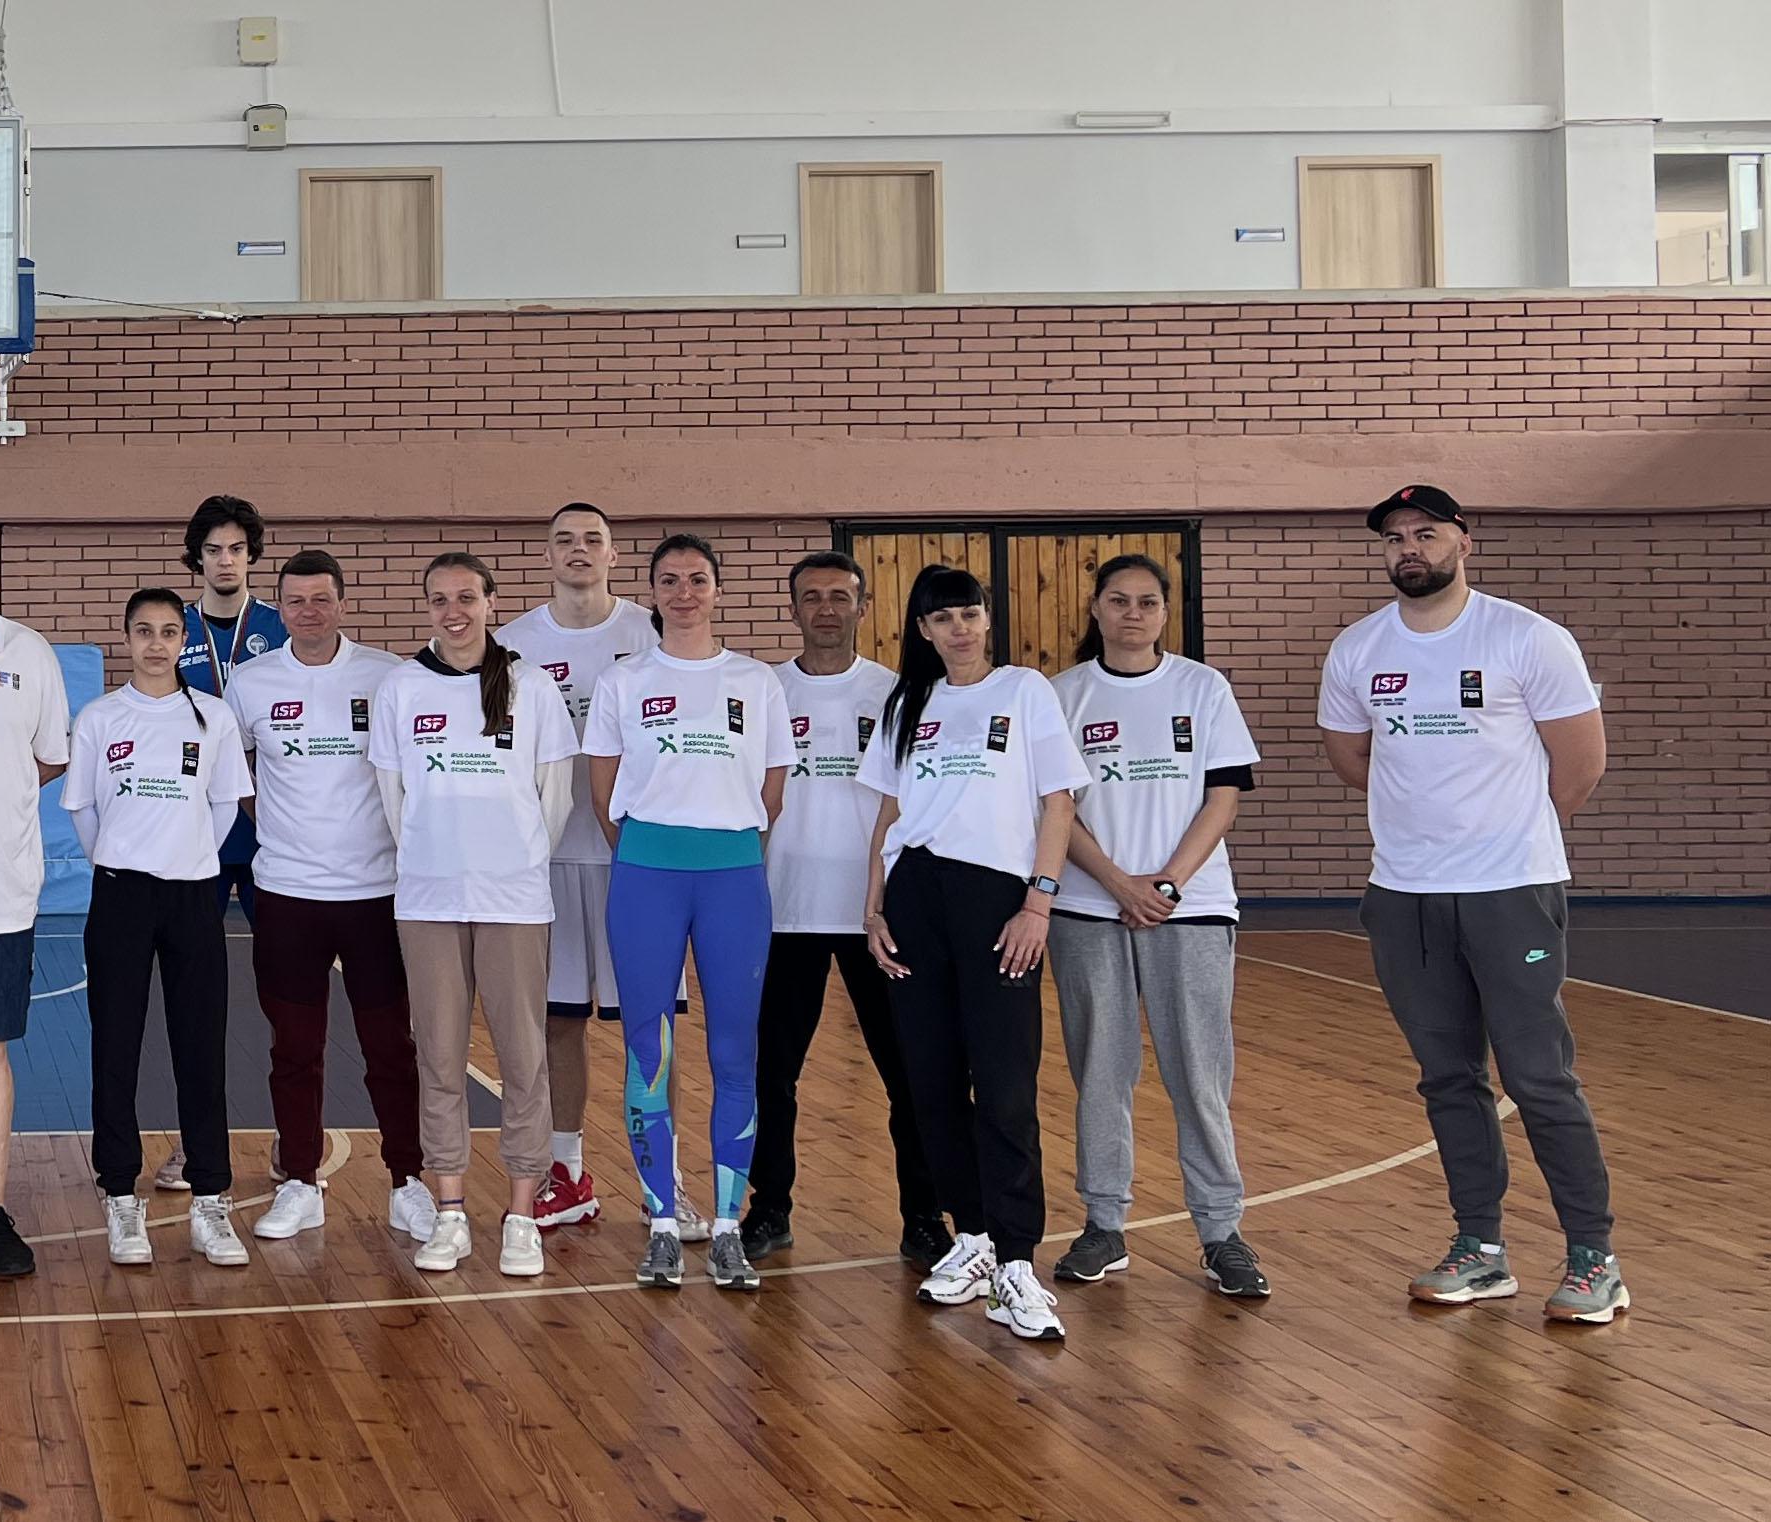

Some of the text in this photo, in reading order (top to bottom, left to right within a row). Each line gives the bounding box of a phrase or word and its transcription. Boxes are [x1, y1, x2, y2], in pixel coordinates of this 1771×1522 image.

[548, 665, 565, 678] SF
[1375, 677, 1404, 691] ISF
[274, 704, 300, 717] ISF
[645, 700, 672, 714] ISF
[417, 717, 444, 730] ISF
[915, 724, 936, 738] SF
[1086, 725, 1114, 740] ISF
[110, 744, 130, 760] ISF
